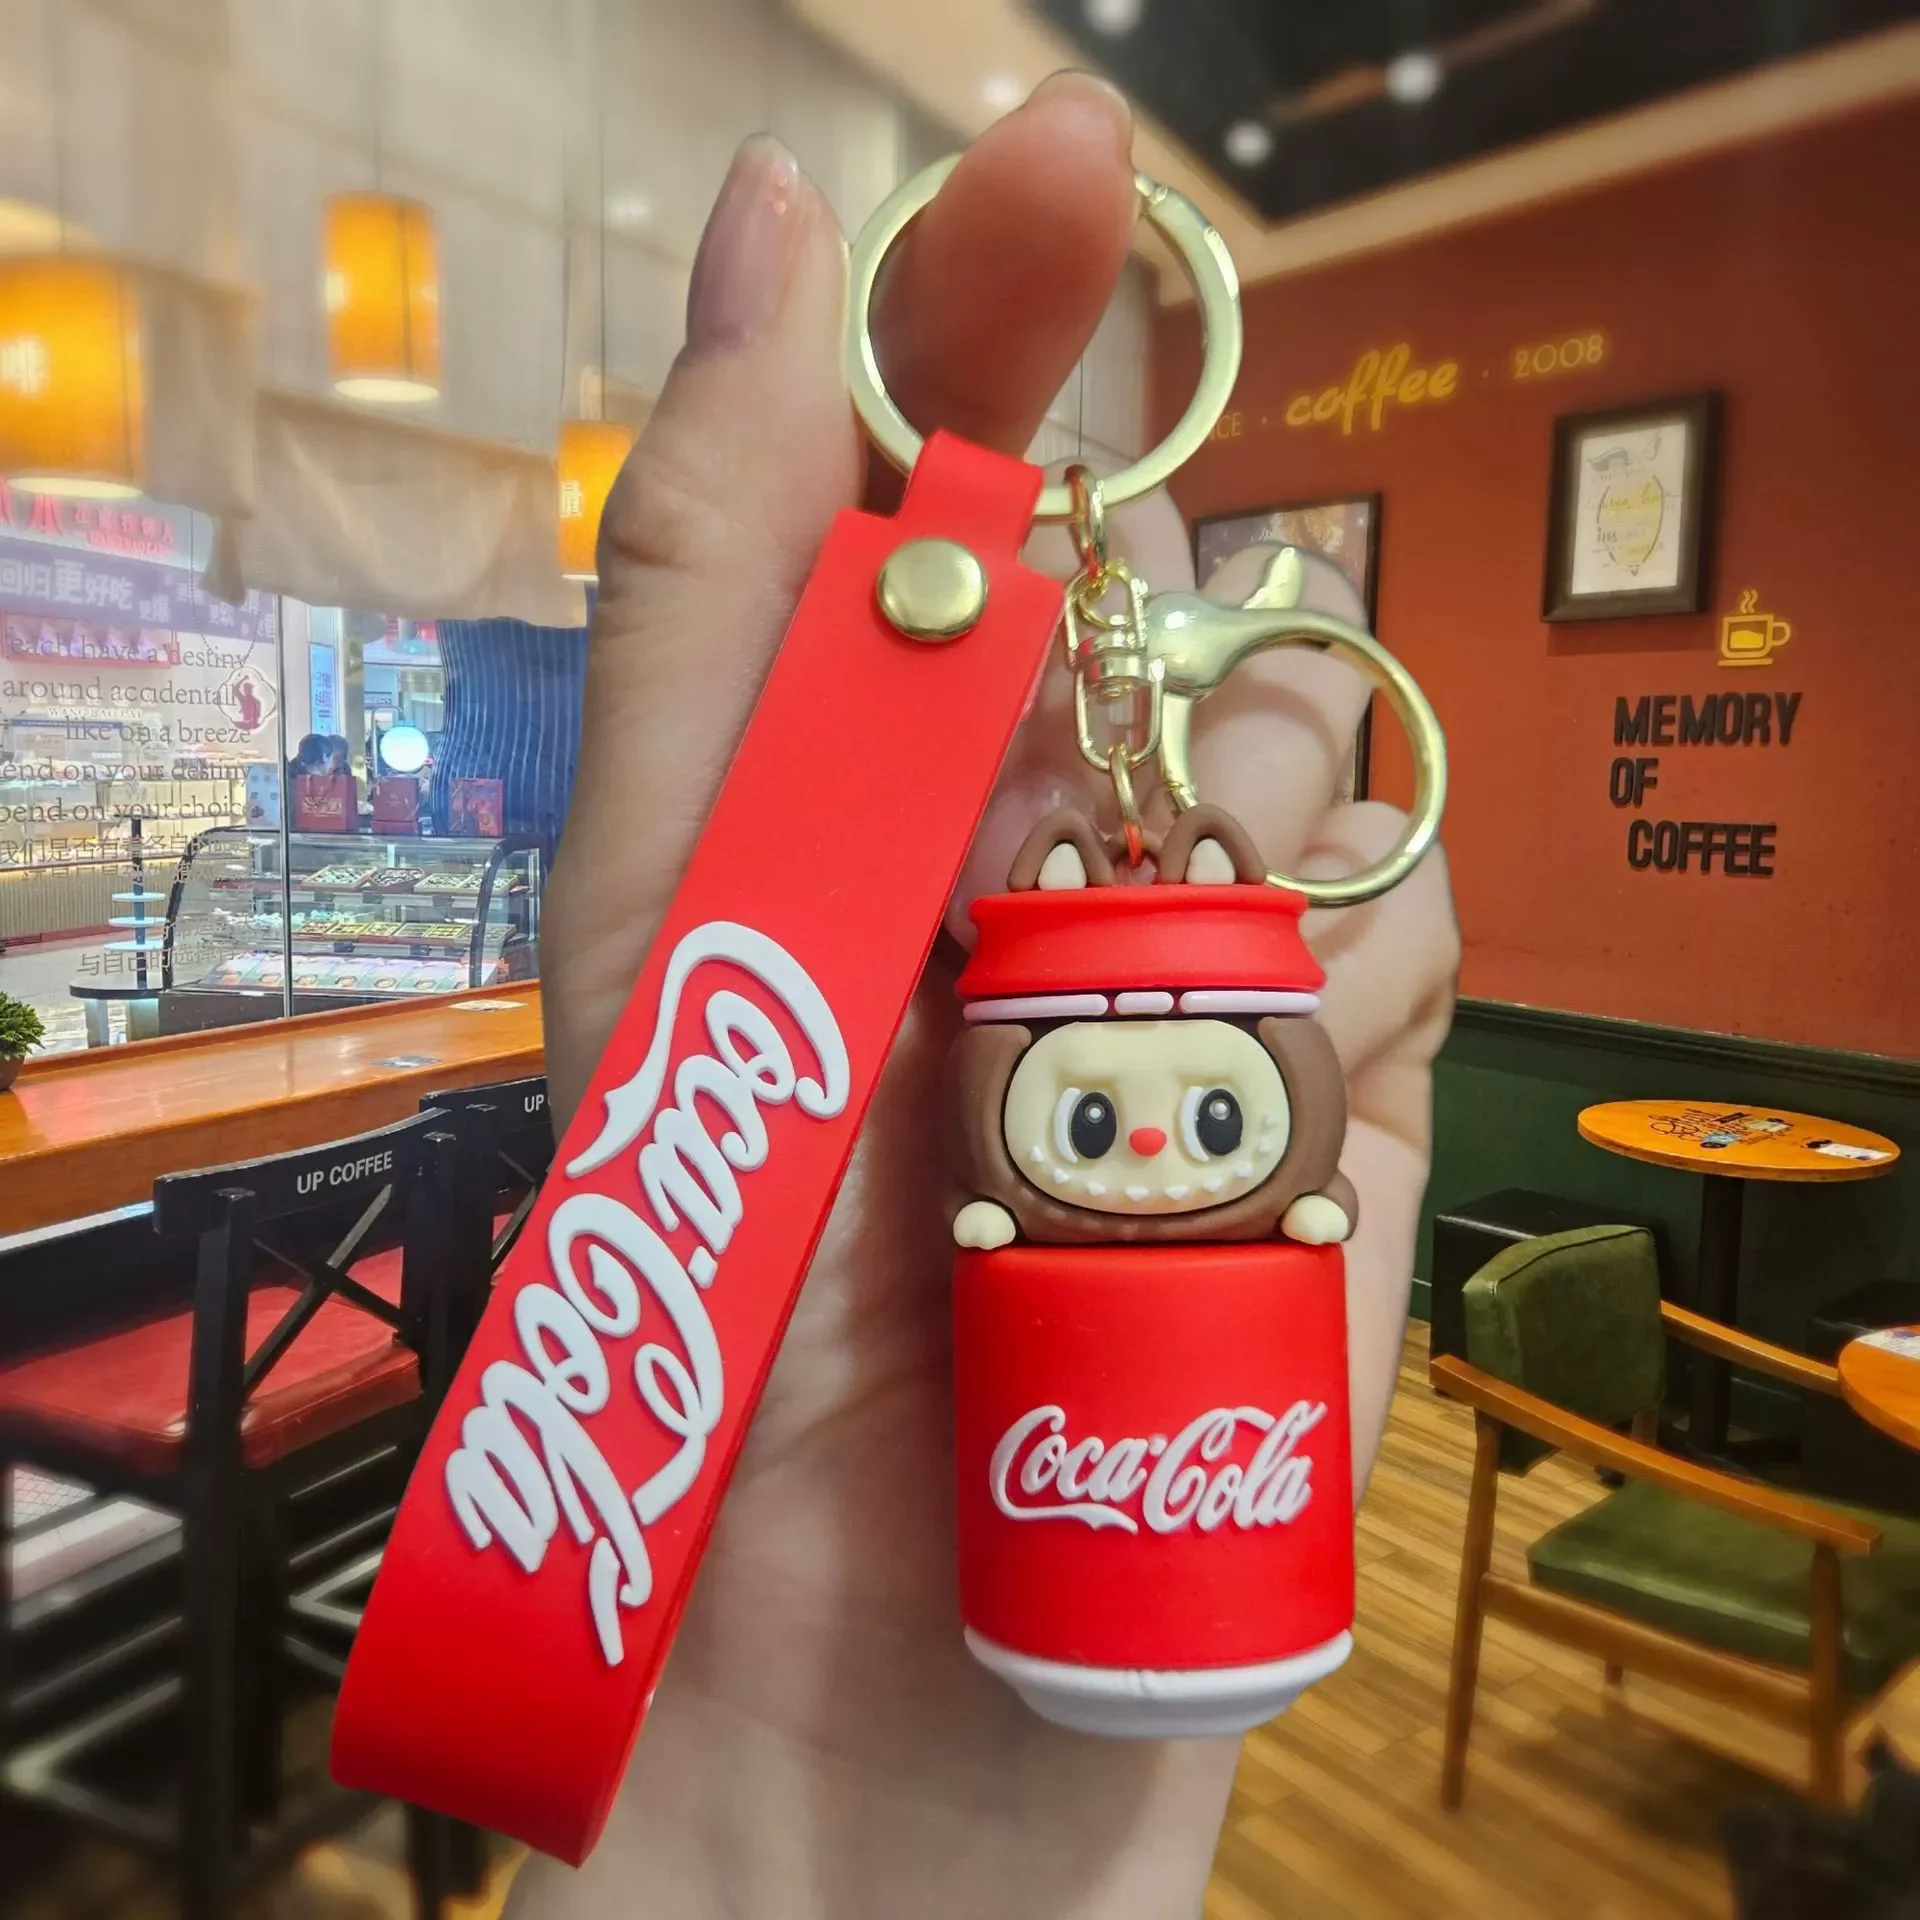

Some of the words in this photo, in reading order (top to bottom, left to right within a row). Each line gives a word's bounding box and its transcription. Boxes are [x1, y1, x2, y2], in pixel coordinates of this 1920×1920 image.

[1286, 343, 1459, 435] coffee
[1514, 335, 1604, 379] 2008
[0, 557, 133, 611] 回归更好吃
[11, 632, 69, 656] each
[81, 634, 139, 661] have
[147, 648, 160, 663] a
[168, 641, 248, 669] destiny
[2, 676, 103, 698] around
[110, 679, 241, 708] accidentall
[65, 714, 112, 741] like
[119, 725, 150, 742] on
[159, 725, 173, 743] a
[177, 719, 252, 744] breeze
[1613, 692, 1802, 746] MEMORY
[64, 764, 97, 780] on
[104, 764, 164, 787] your
[171, 758, 253, 788] destiny
[1609, 757, 1659, 807] OF
[72, 804, 107, 821] on
[113, 803, 172, 827] your
[1627, 819, 1777, 877] COFFEE
[524, 1094, 545, 1113] UP
[297, 1171, 324, 1194] UP
[330, 1151, 393, 1187] COFFEE
[446, 920, 851, 1666] Coca-Cola
[989, 1399, 1328, 1533] Coca-Cola
